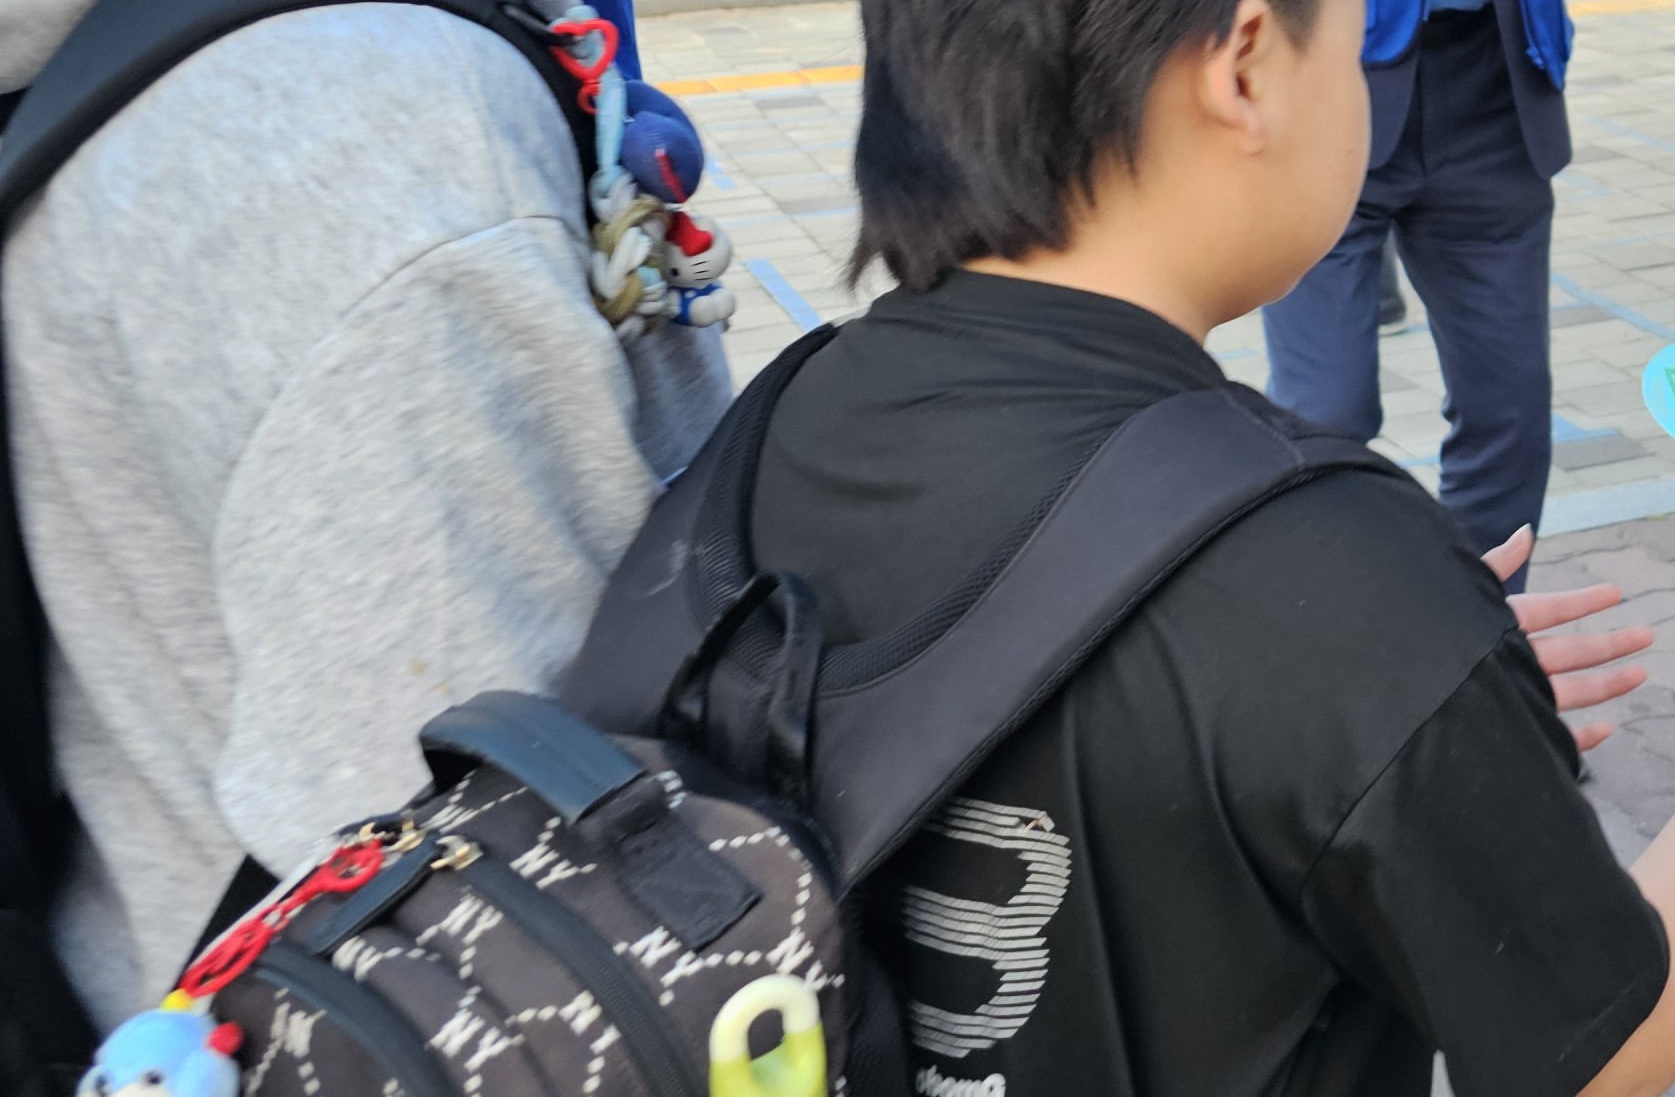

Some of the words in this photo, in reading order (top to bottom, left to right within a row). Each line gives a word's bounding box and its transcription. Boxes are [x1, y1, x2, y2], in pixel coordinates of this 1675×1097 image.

[509, 840, 580, 889] NY
[629, 926, 704, 988] NY
[430, 1012, 513, 1072] NY
